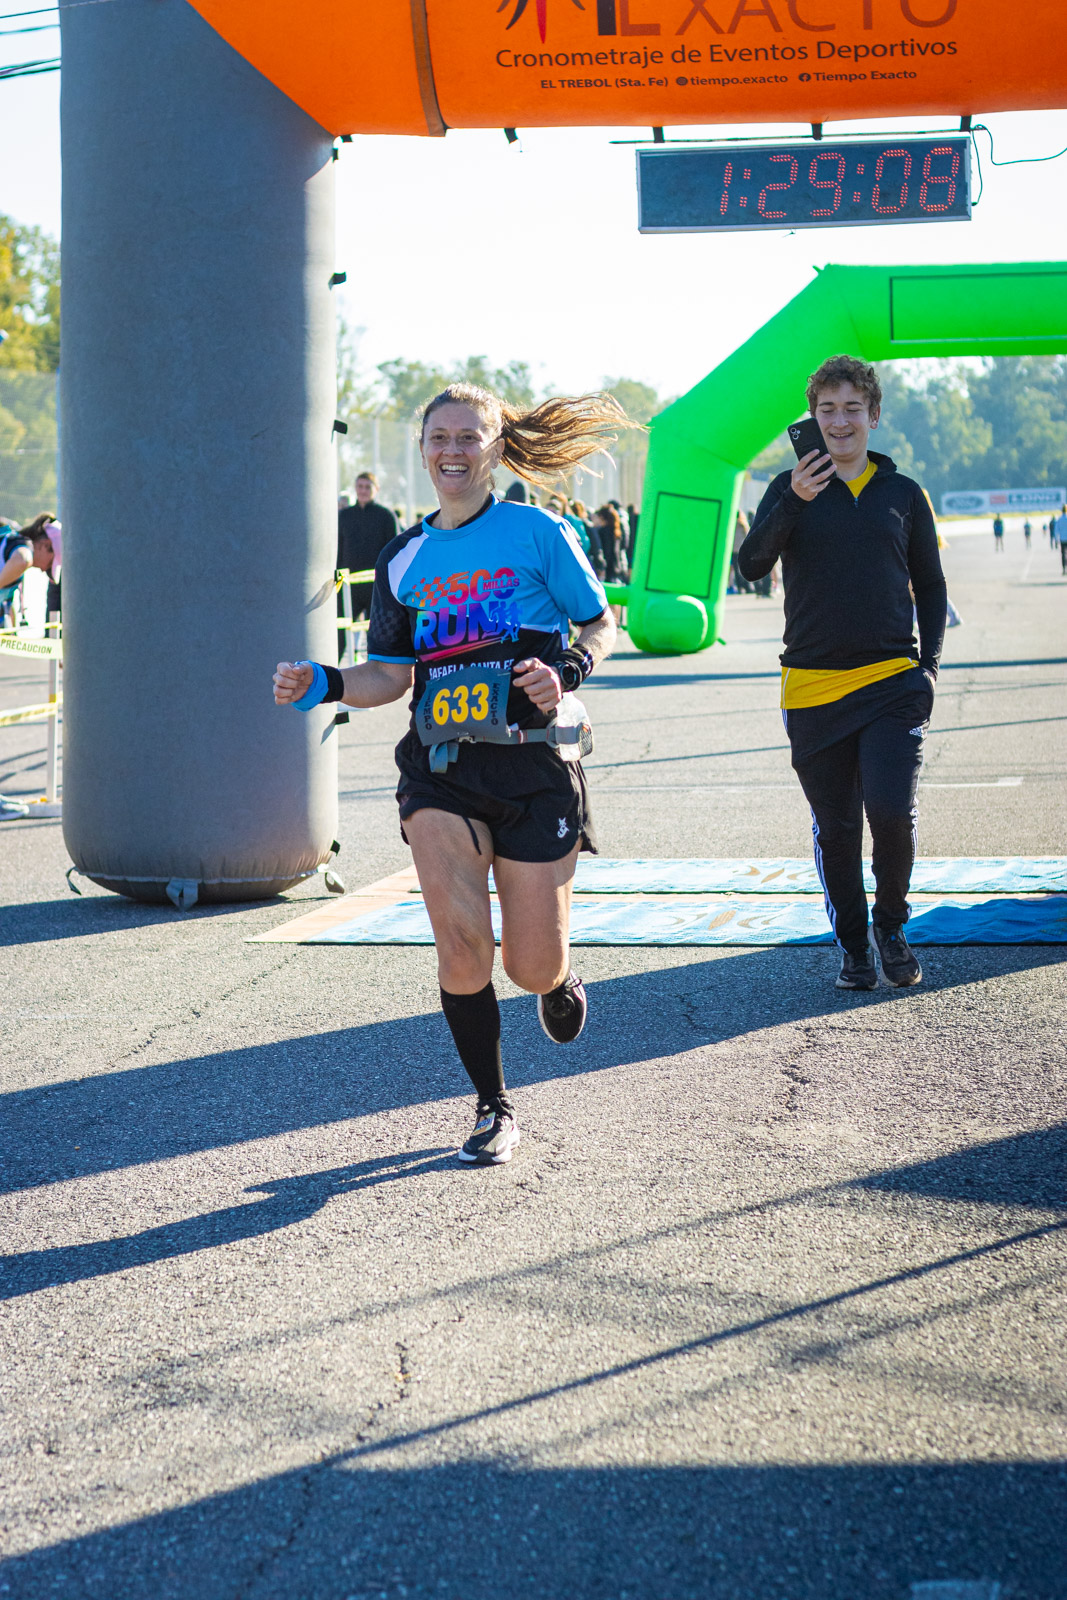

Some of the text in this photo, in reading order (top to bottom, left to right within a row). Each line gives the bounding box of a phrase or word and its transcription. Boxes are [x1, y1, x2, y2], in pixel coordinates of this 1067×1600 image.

[496, 38, 958, 69] Cronometraje de Eventos Deportivos
[540, 70, 918, 89] EL TREBOL (Sta. Fe) tiempo.exacto Tiempo Exacto
[720, 147, 960, 218] 1:29:08
[483, 577, 520, 590] MILLAS
[414, 601, 504, 650] RUN
[0, 638, 53, 654] PRECAUCION
[432, 682, 490, 726] 633
